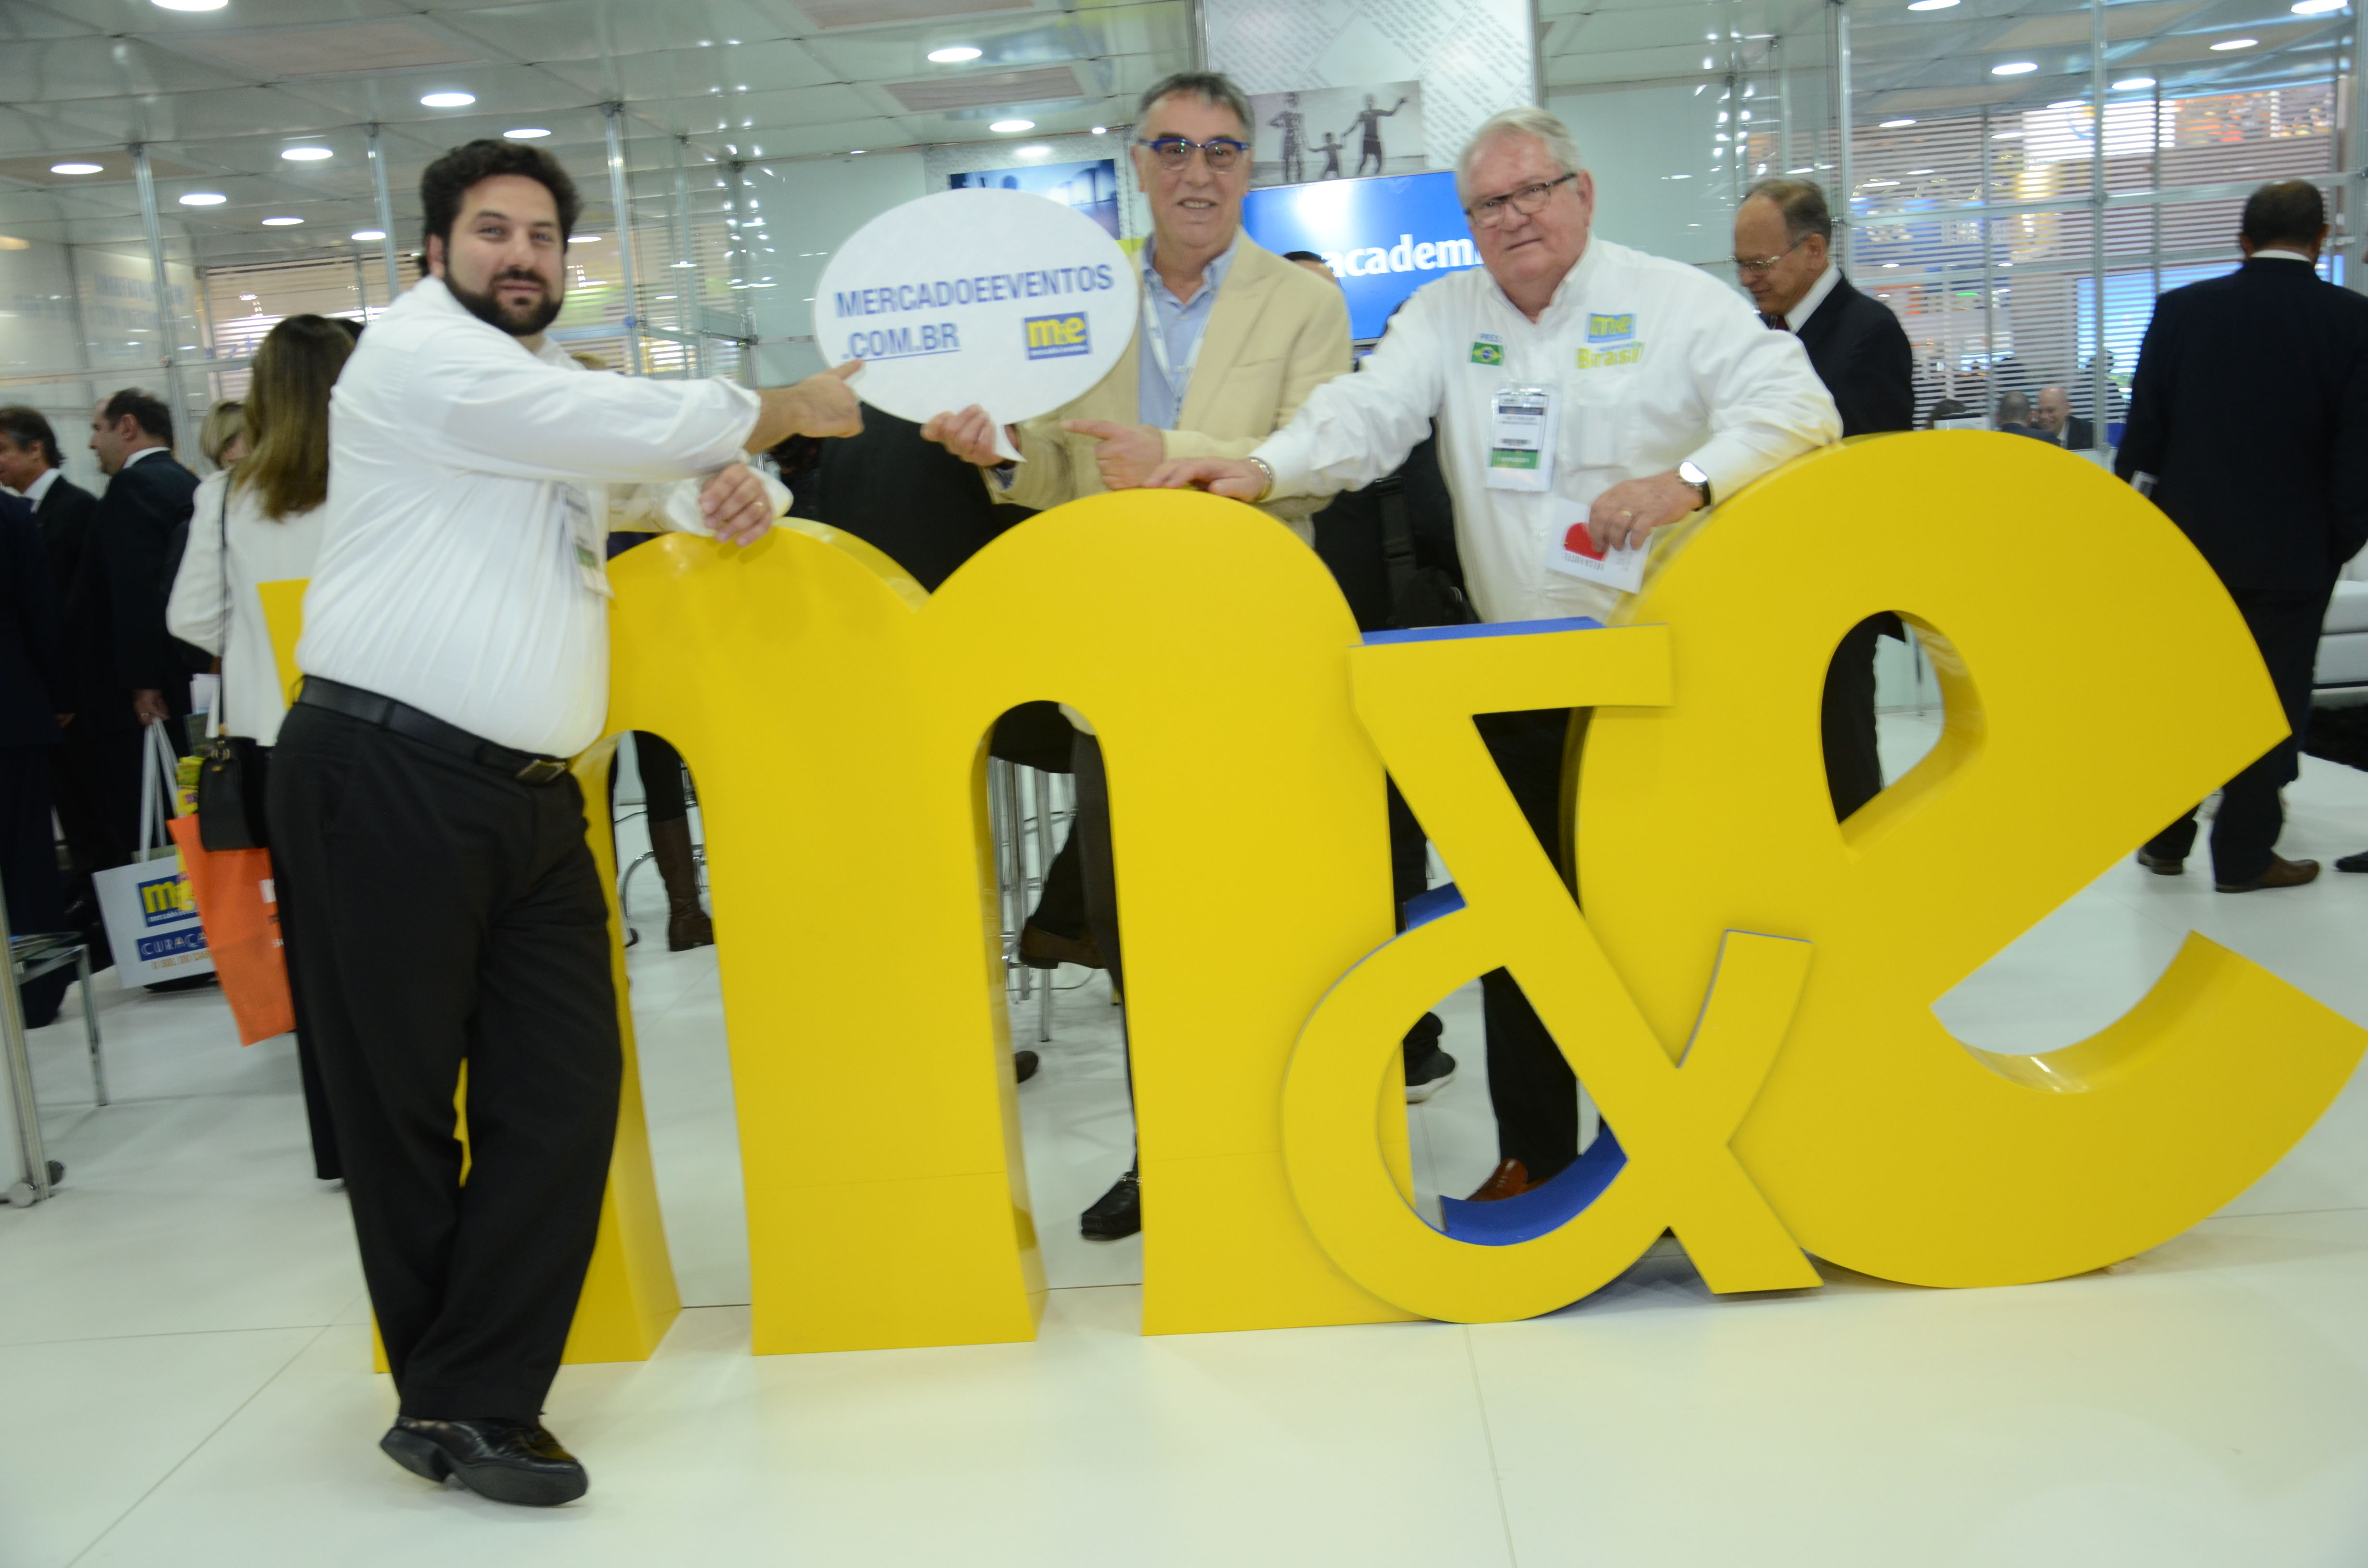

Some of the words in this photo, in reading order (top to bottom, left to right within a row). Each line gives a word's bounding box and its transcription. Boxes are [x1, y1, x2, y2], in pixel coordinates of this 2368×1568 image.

[1321, 234, 1484, 277] academ
[834, 264, 1114, 318] MERCADOEEVENTOS
[841, 322, 960, 359] .COM.BR
